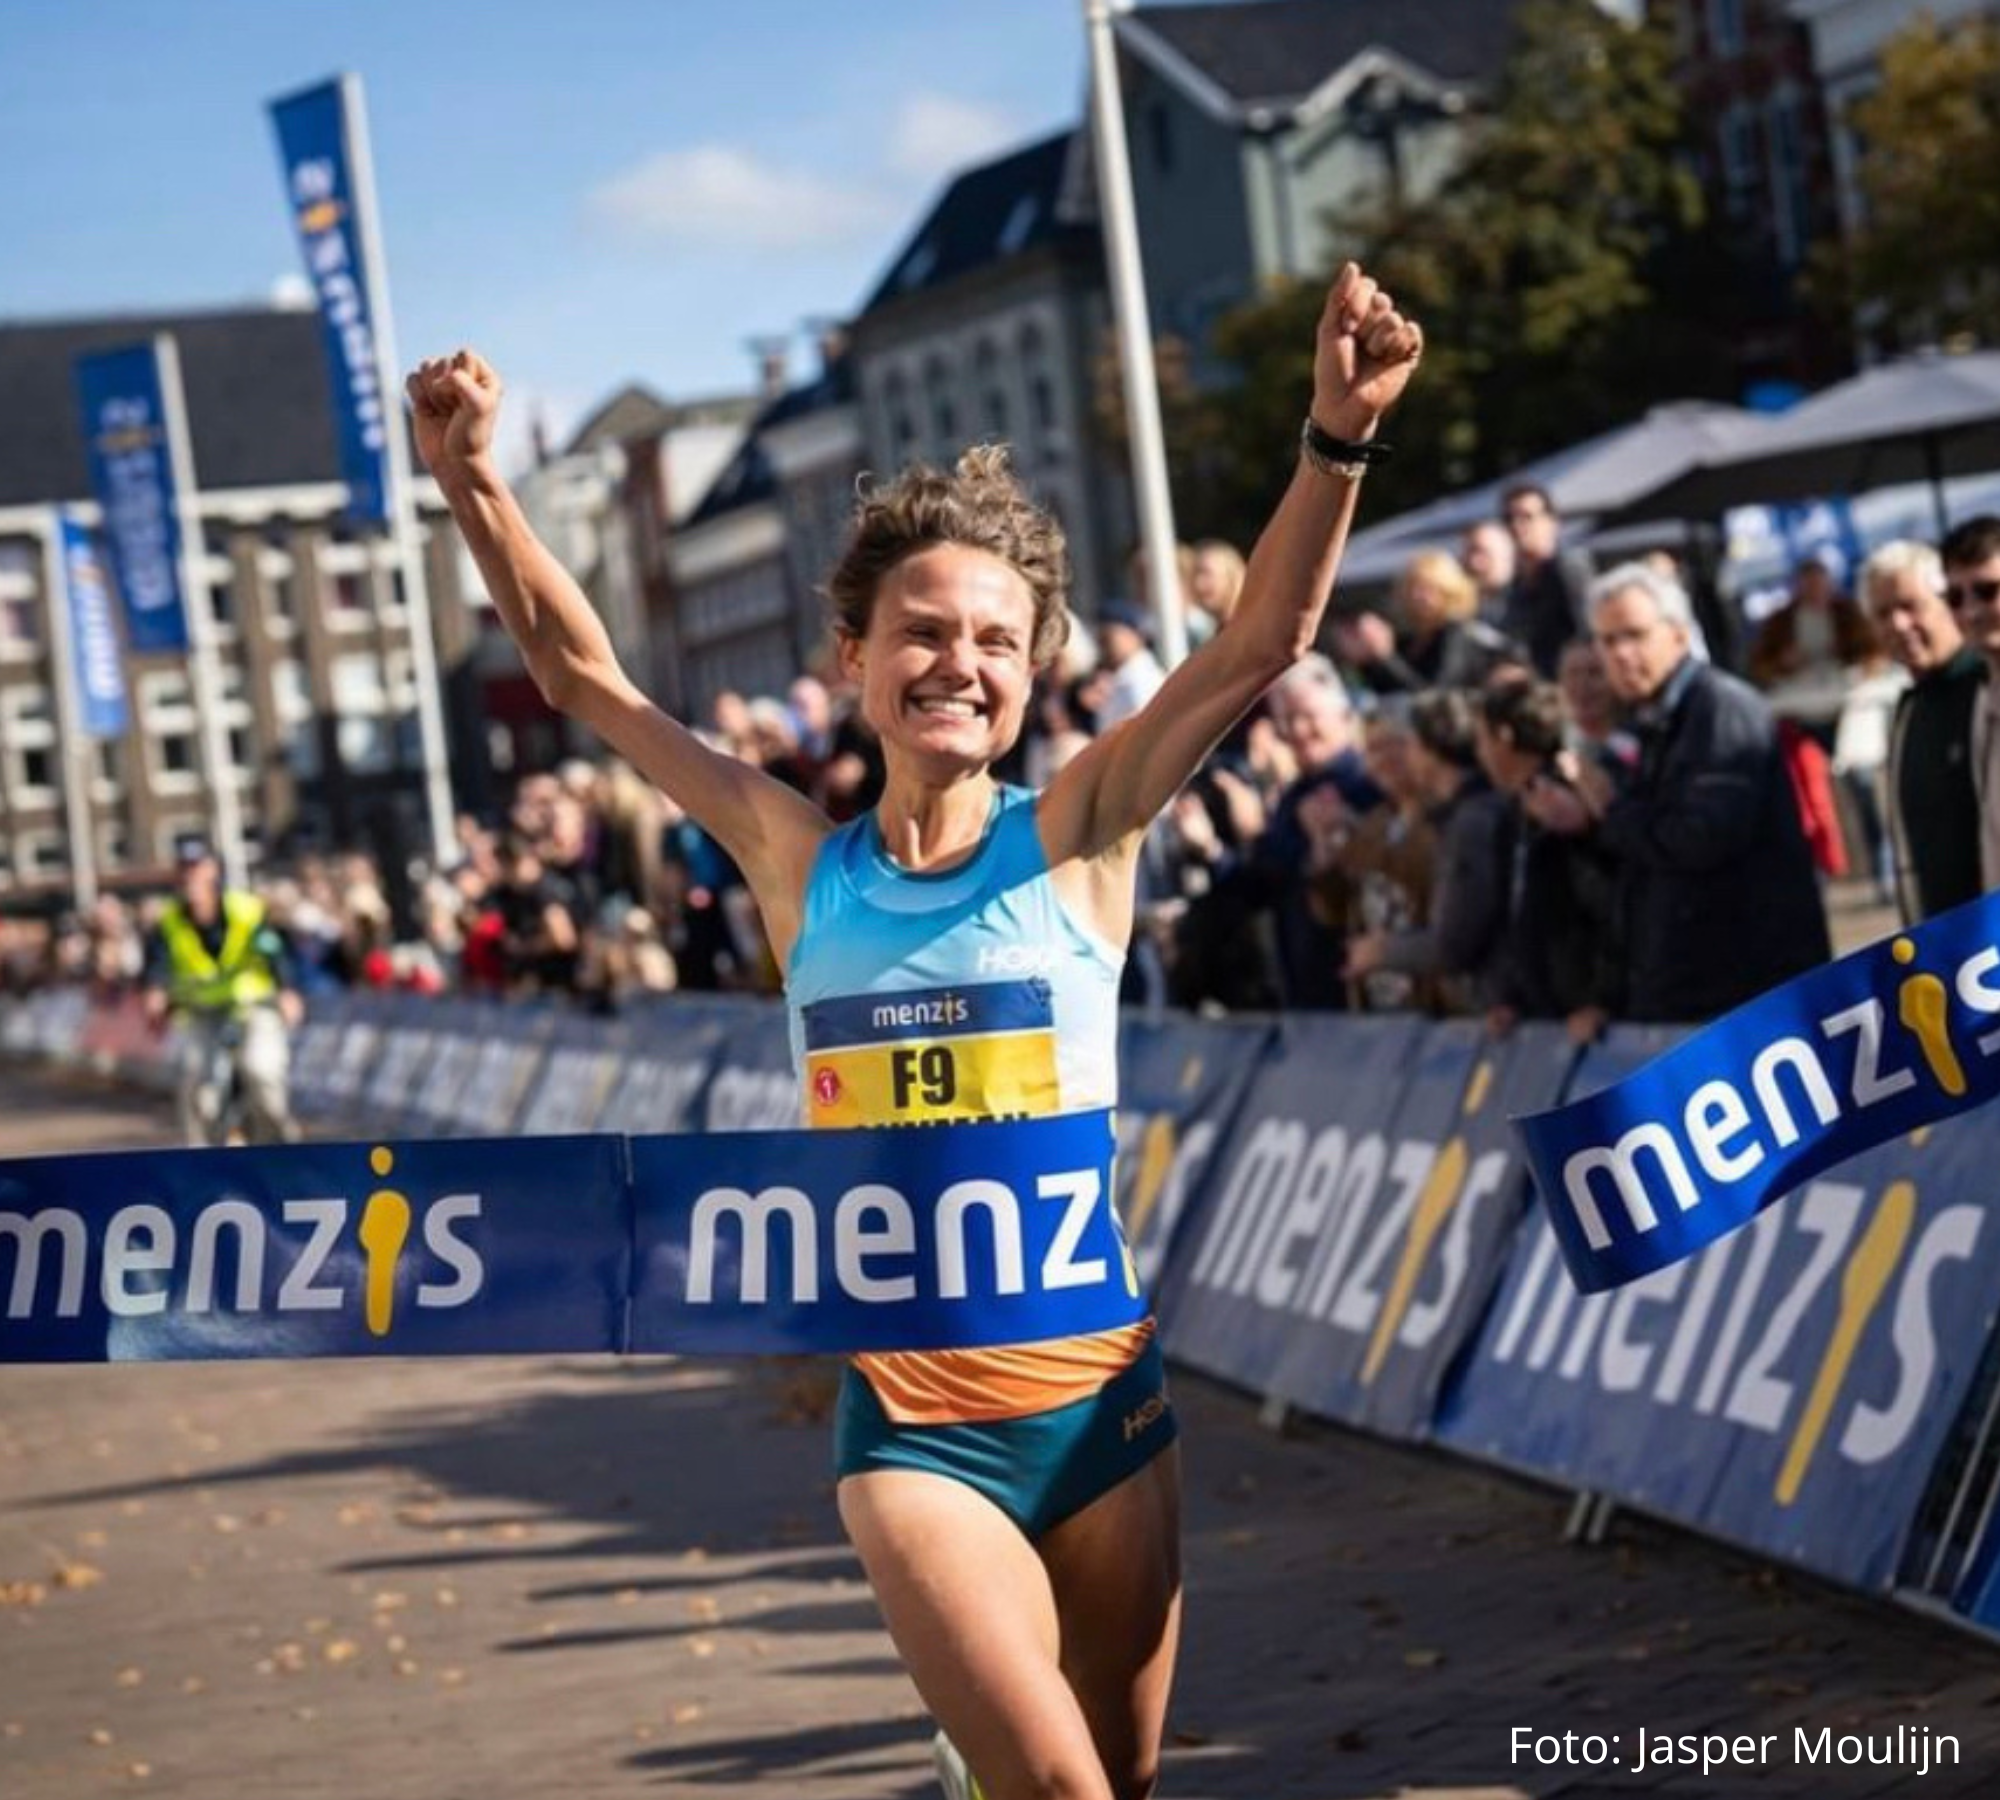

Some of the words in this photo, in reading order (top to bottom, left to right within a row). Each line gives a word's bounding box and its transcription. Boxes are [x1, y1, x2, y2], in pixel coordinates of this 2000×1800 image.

[872, 993, 969, 1028] menzis
[891, 1046, 957, 1109] F9
[1562, 937, 2000, 1252] menzis
[0, 1146, 485, 1337] menzis
[686, 1115, 1138, 1305] menz
[1191, 1060, 1509, 1390] menzis
